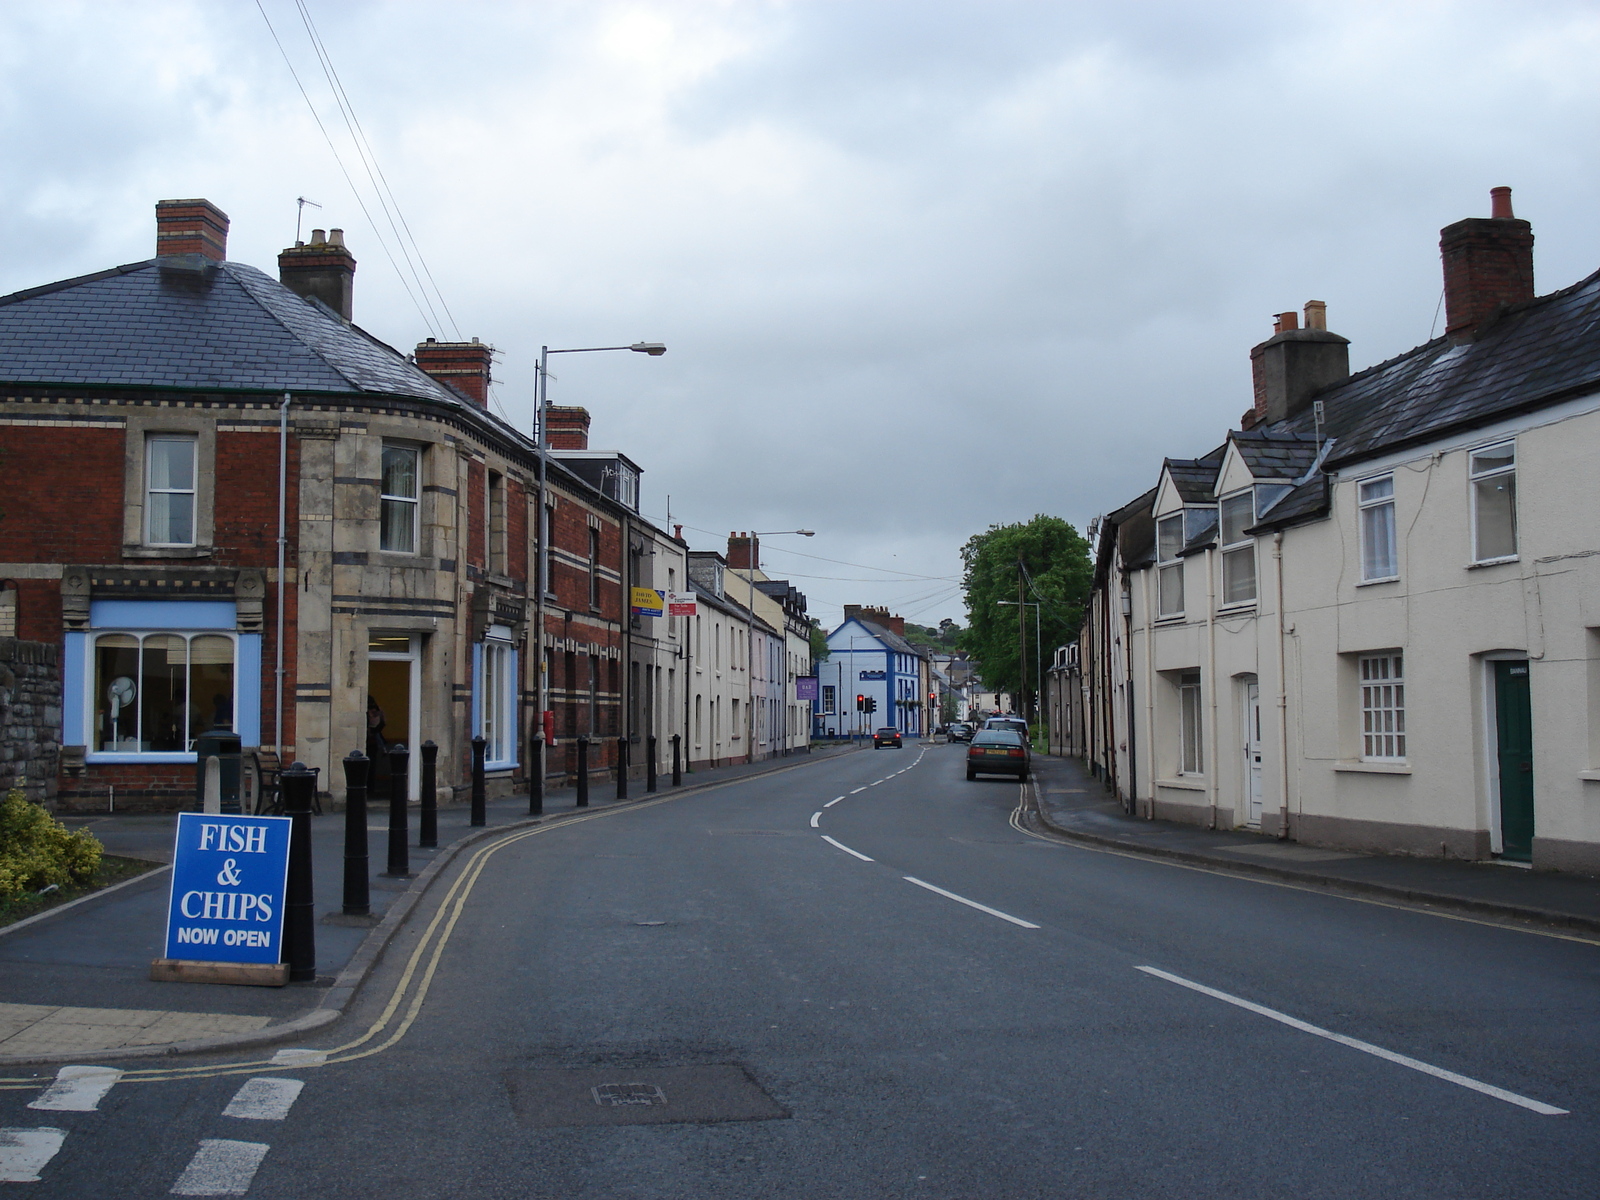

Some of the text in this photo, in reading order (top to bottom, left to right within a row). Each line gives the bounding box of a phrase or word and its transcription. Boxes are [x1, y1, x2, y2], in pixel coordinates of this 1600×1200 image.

[198, 824, 269, 853] FISH
[217, 858, 242, 886] &
[181, 890, 273, 922] CHIPS
[177, 927, 271, 948] NOW OPEN
